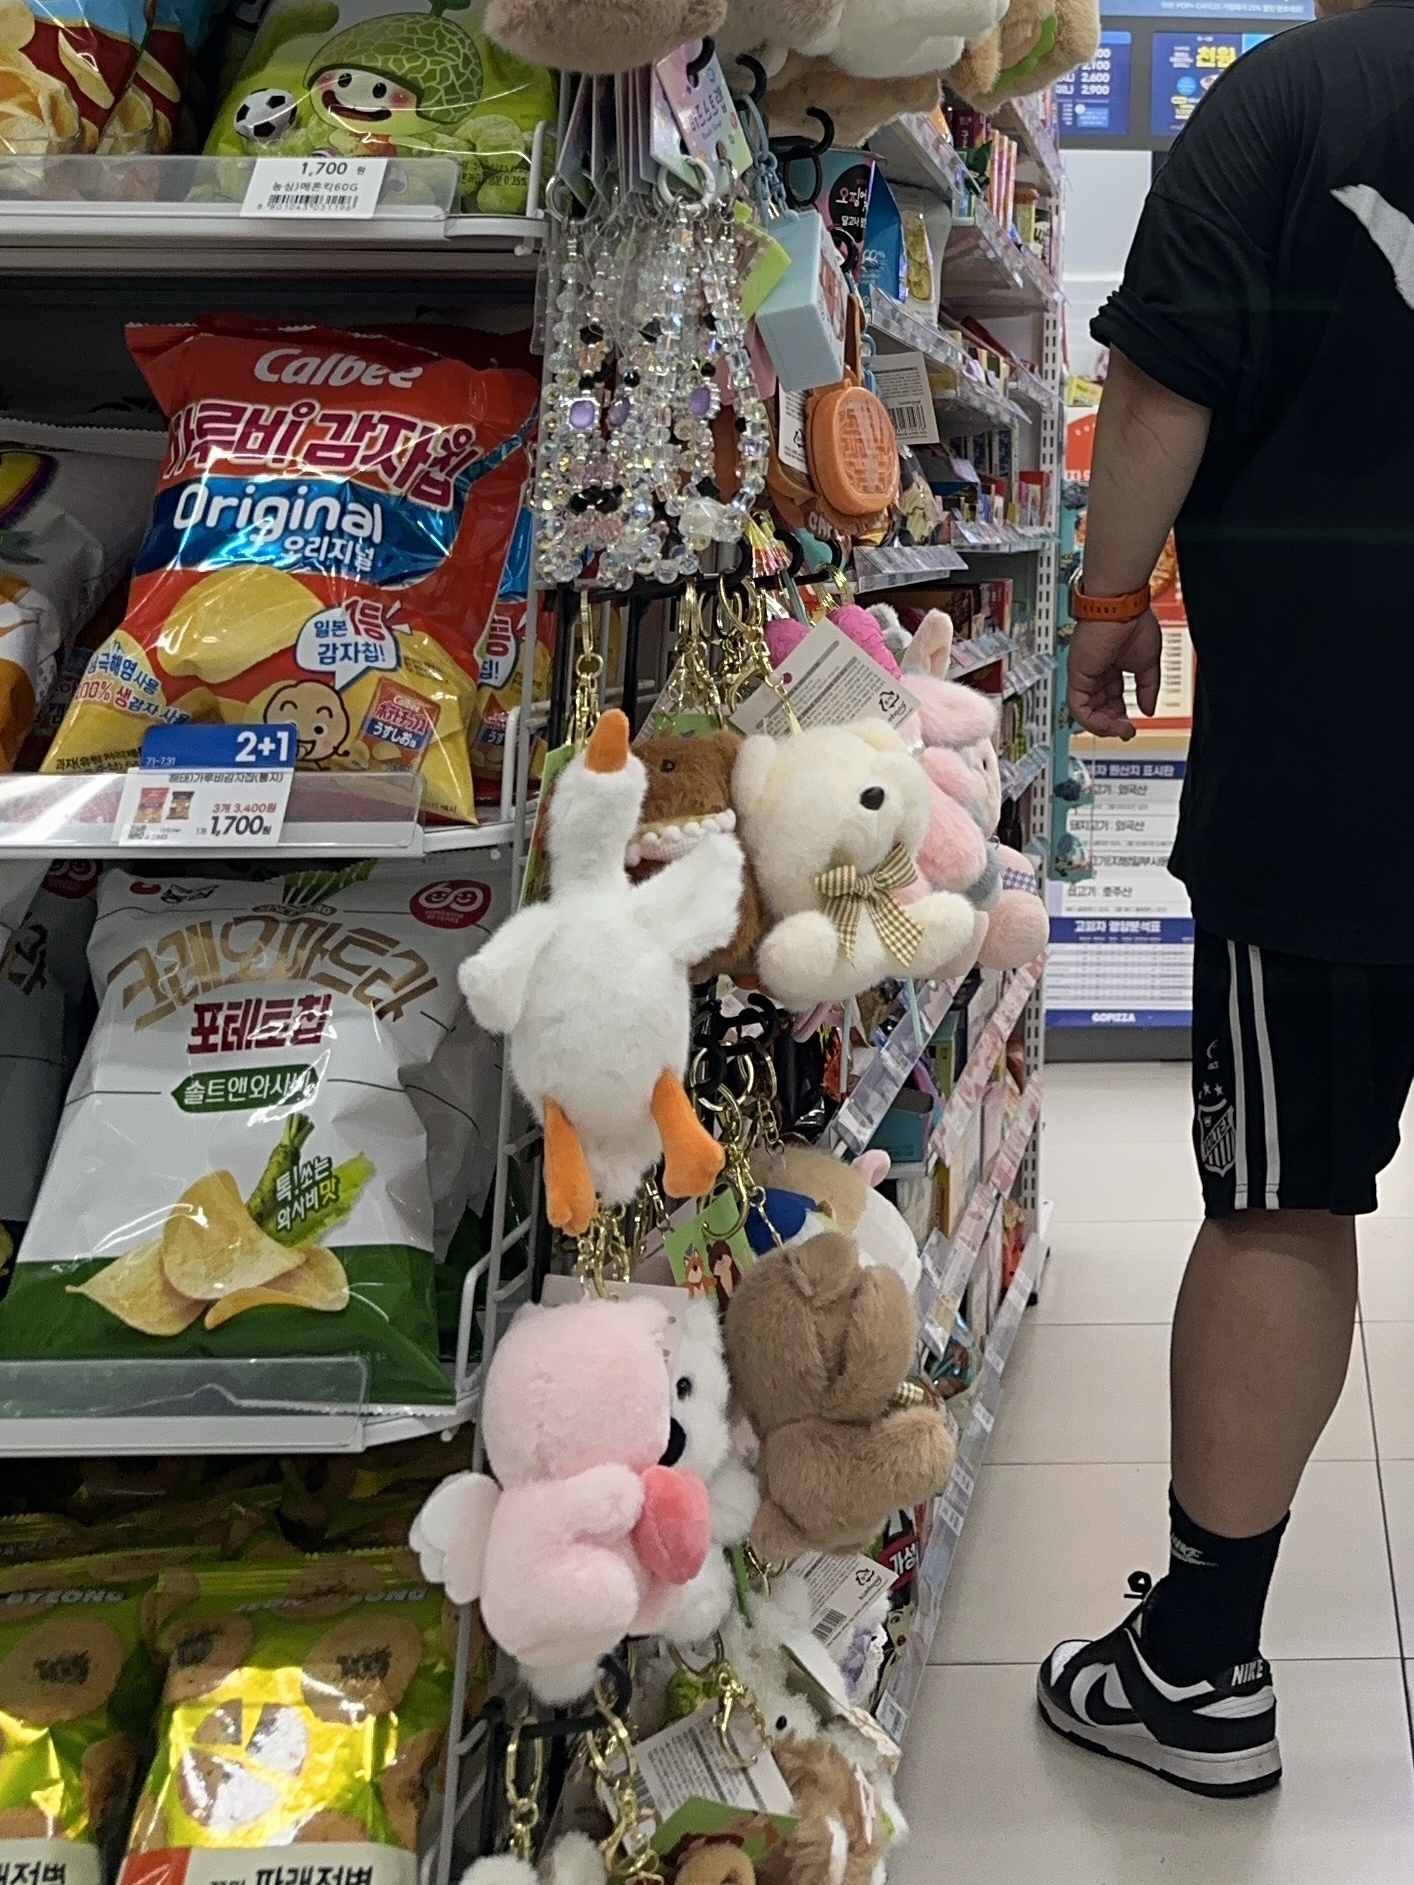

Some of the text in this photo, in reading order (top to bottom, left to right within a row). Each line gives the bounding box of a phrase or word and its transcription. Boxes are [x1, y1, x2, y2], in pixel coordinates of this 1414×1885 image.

[300, 162, 366, 177] 1,700 원
[271, 181, 359, 193] 농심)메론킥60G
[253, 347, 424, 392] Calbee
[172, 483, 384, 546] Original
[281, 537, 377, 573] 오리지널
[313, 619, 348, 638] 일본
[317, 642, 387, 666] 감자칩!
[113, 685, 162, 717] 생감자
[392, 695, 422, 713] Calbee
[234, 730, 290, 763] 2+1
[212, 802, 231, 814] 3개
[186, 991, 334, 1057] 포테토칩
[275, 1155, 333, 1202] 톡! 쏘는
[1231, 1660, 1265, 1688] NIKE
